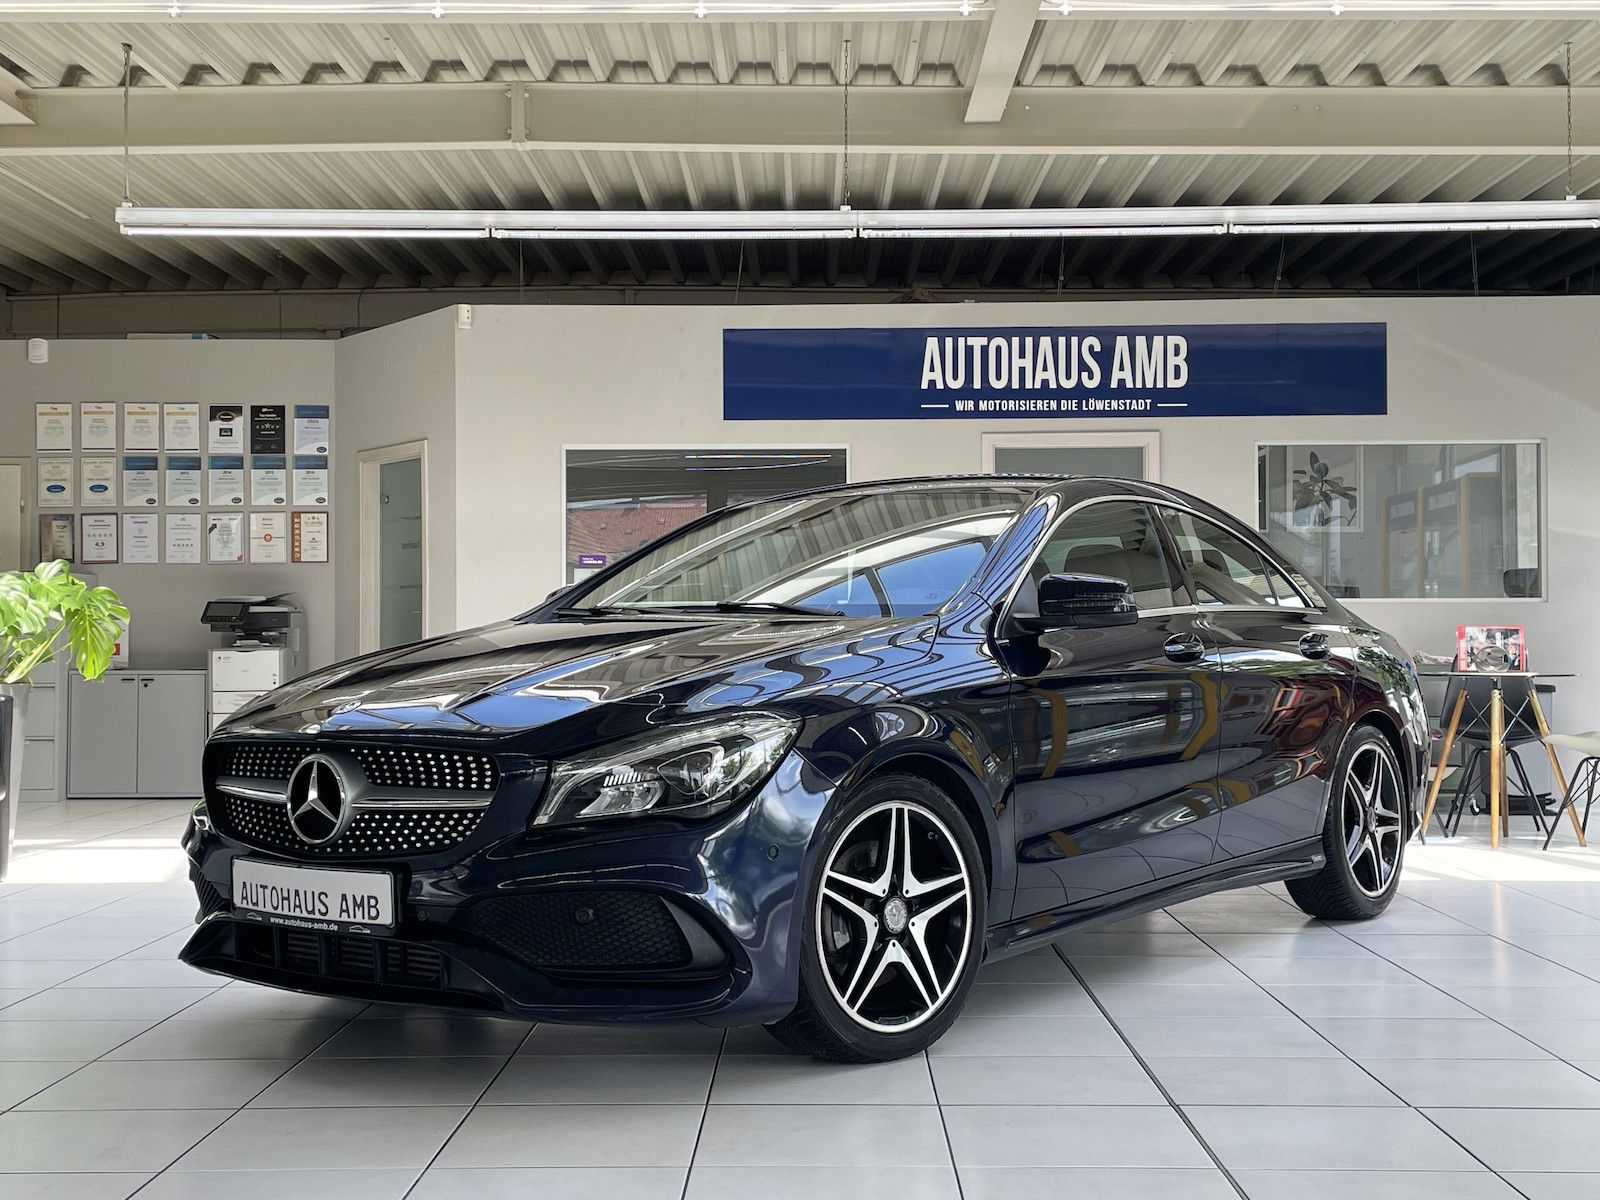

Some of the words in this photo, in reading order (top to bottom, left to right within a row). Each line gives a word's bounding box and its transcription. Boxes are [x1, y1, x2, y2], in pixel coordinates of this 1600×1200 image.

[920, 336, 1102, 390] AUTOHAUS
[1110, 335, 1189, 389] AMB
[955, 400, 975, 412] WIR
[979, 400, 1058, 412] MOTORISIEREN
[1061, 400, 1079, 411] DIE
[1082, 397, 1152, 411] LÖWENSTADT
[240, 881, 329, 917] AUTOHAUS
[339, 893, 380, 921] AMB
[269, 916, 339, 931] www.autohaus-amb.de
